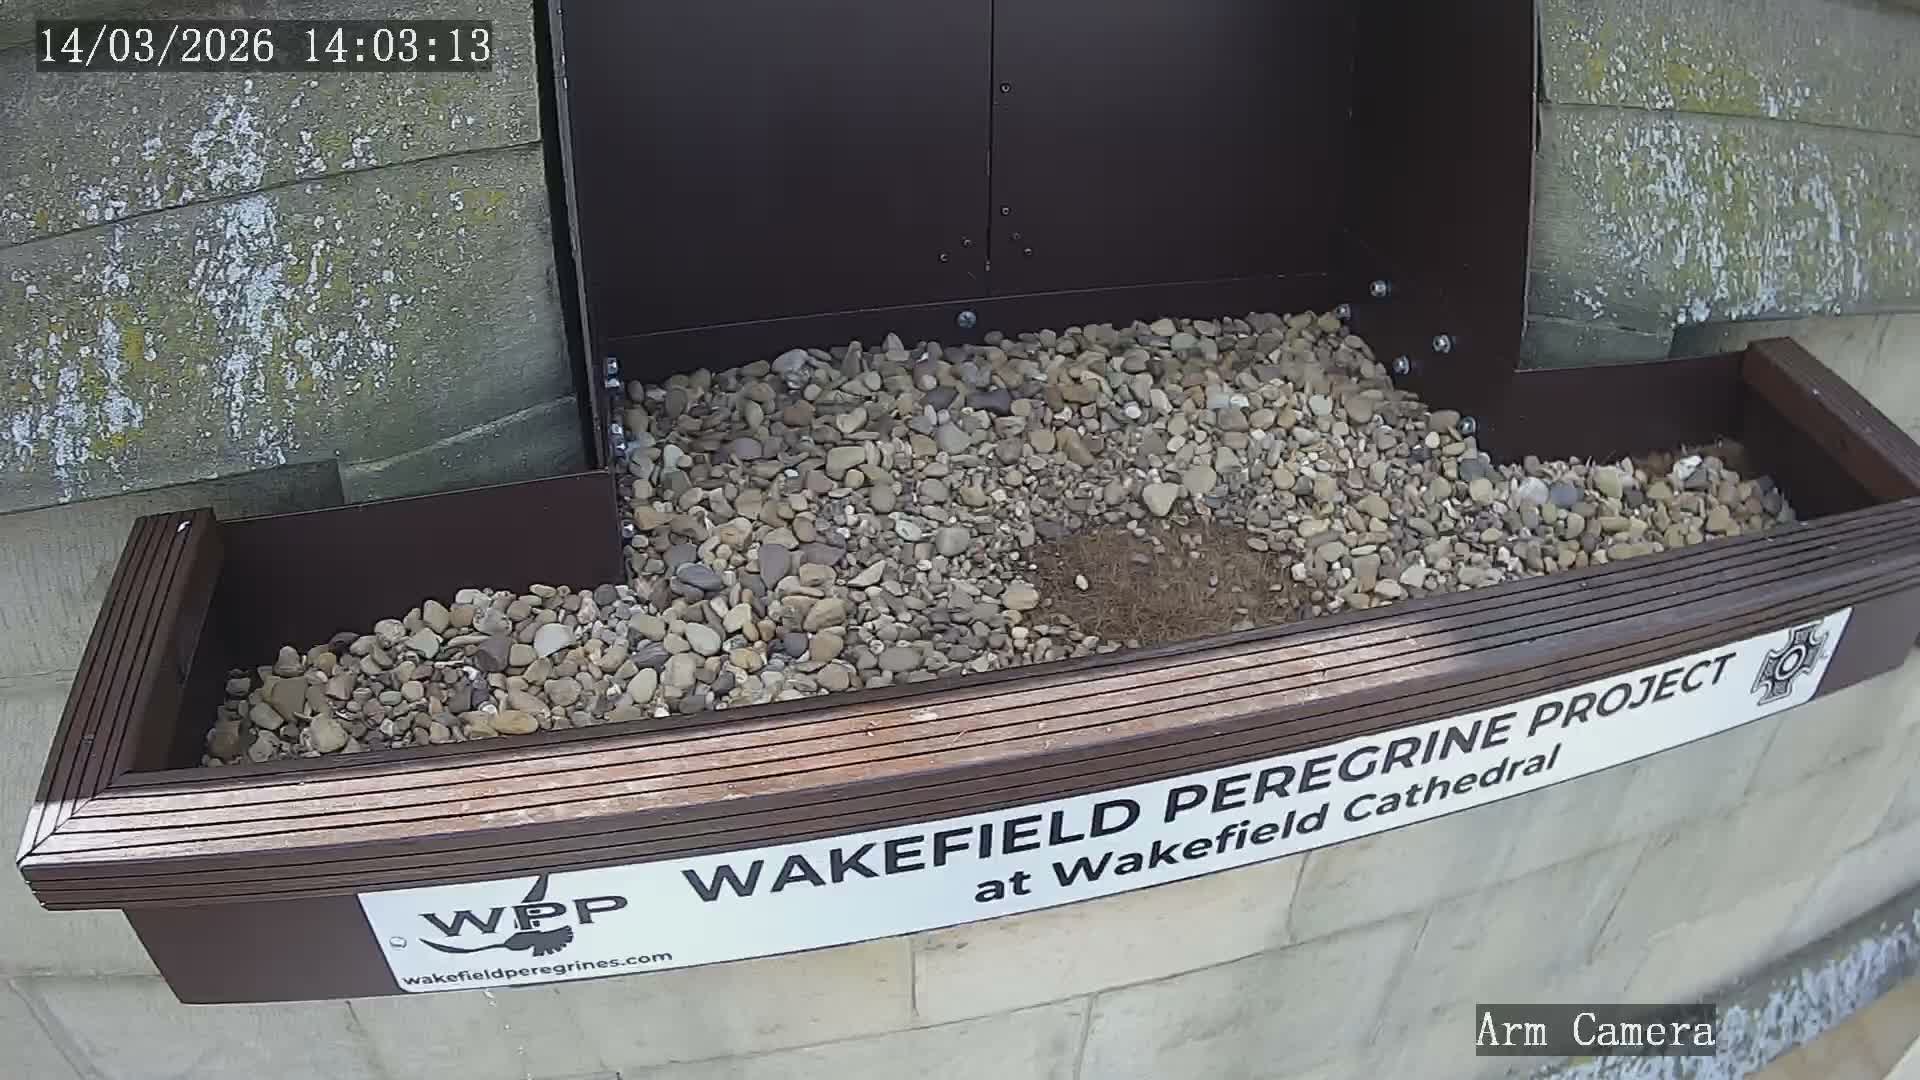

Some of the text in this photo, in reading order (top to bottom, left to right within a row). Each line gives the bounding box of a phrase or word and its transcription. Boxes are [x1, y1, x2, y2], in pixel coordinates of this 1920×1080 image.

[682, 652, 1737, 902] WAKEFIELD PEREGRINE PROJECT
[974, 744, 1562, 903] at Wakefield Cathedral
[419, 895, 628, 936] WPP
[403, 949, 673, 986] wakefieldperegrines.com
